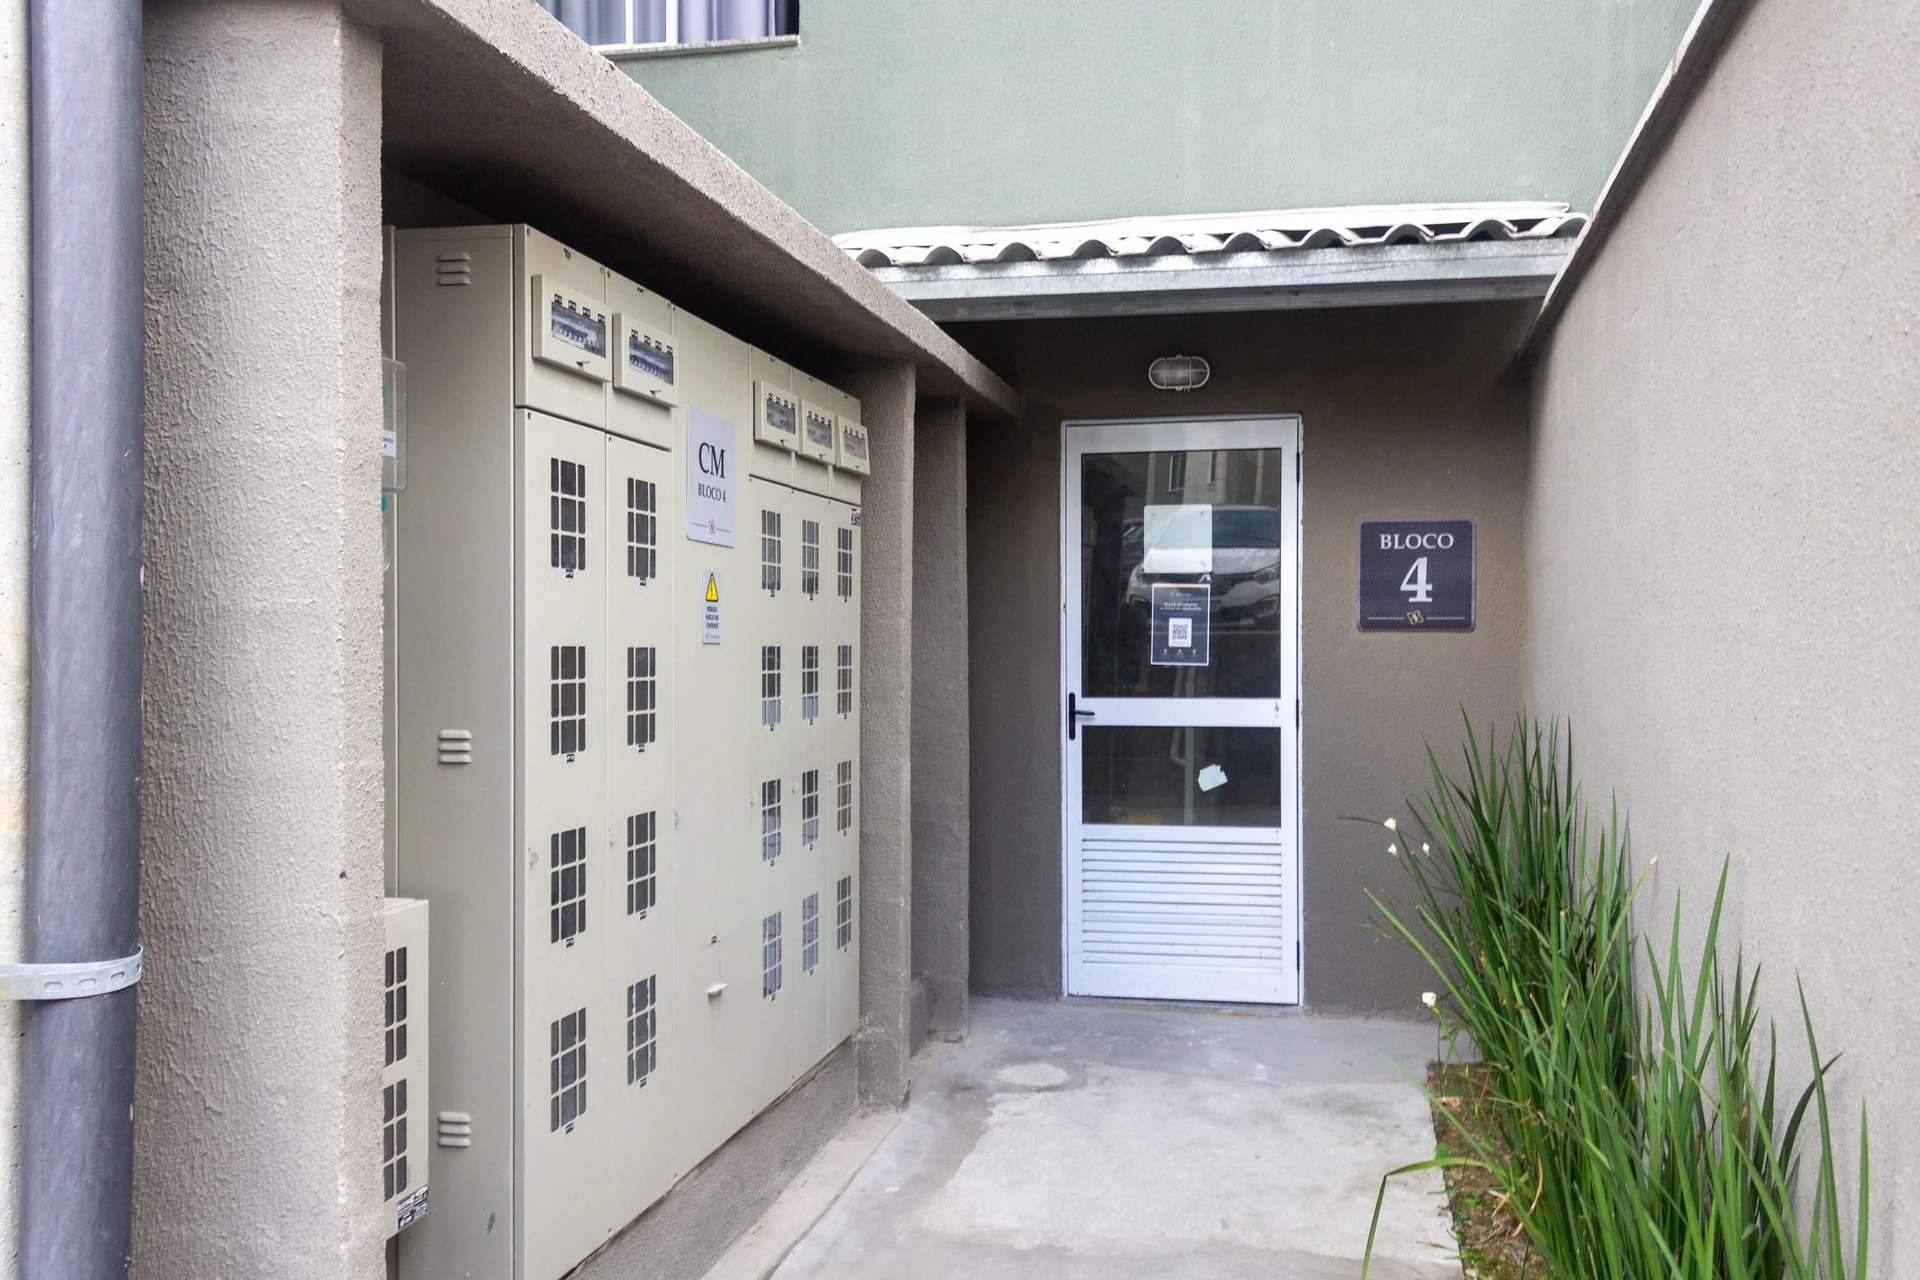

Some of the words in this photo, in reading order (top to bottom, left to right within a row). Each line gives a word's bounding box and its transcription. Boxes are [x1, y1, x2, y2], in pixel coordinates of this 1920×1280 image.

[698, 442, 726, 479] CM
[698, 482, 721, 502] BLOCO
[722, 490, 727, 503] 4
[1379, 532, 1455, 550] BLOCO
[1400, 556, 1433, 603] 4
